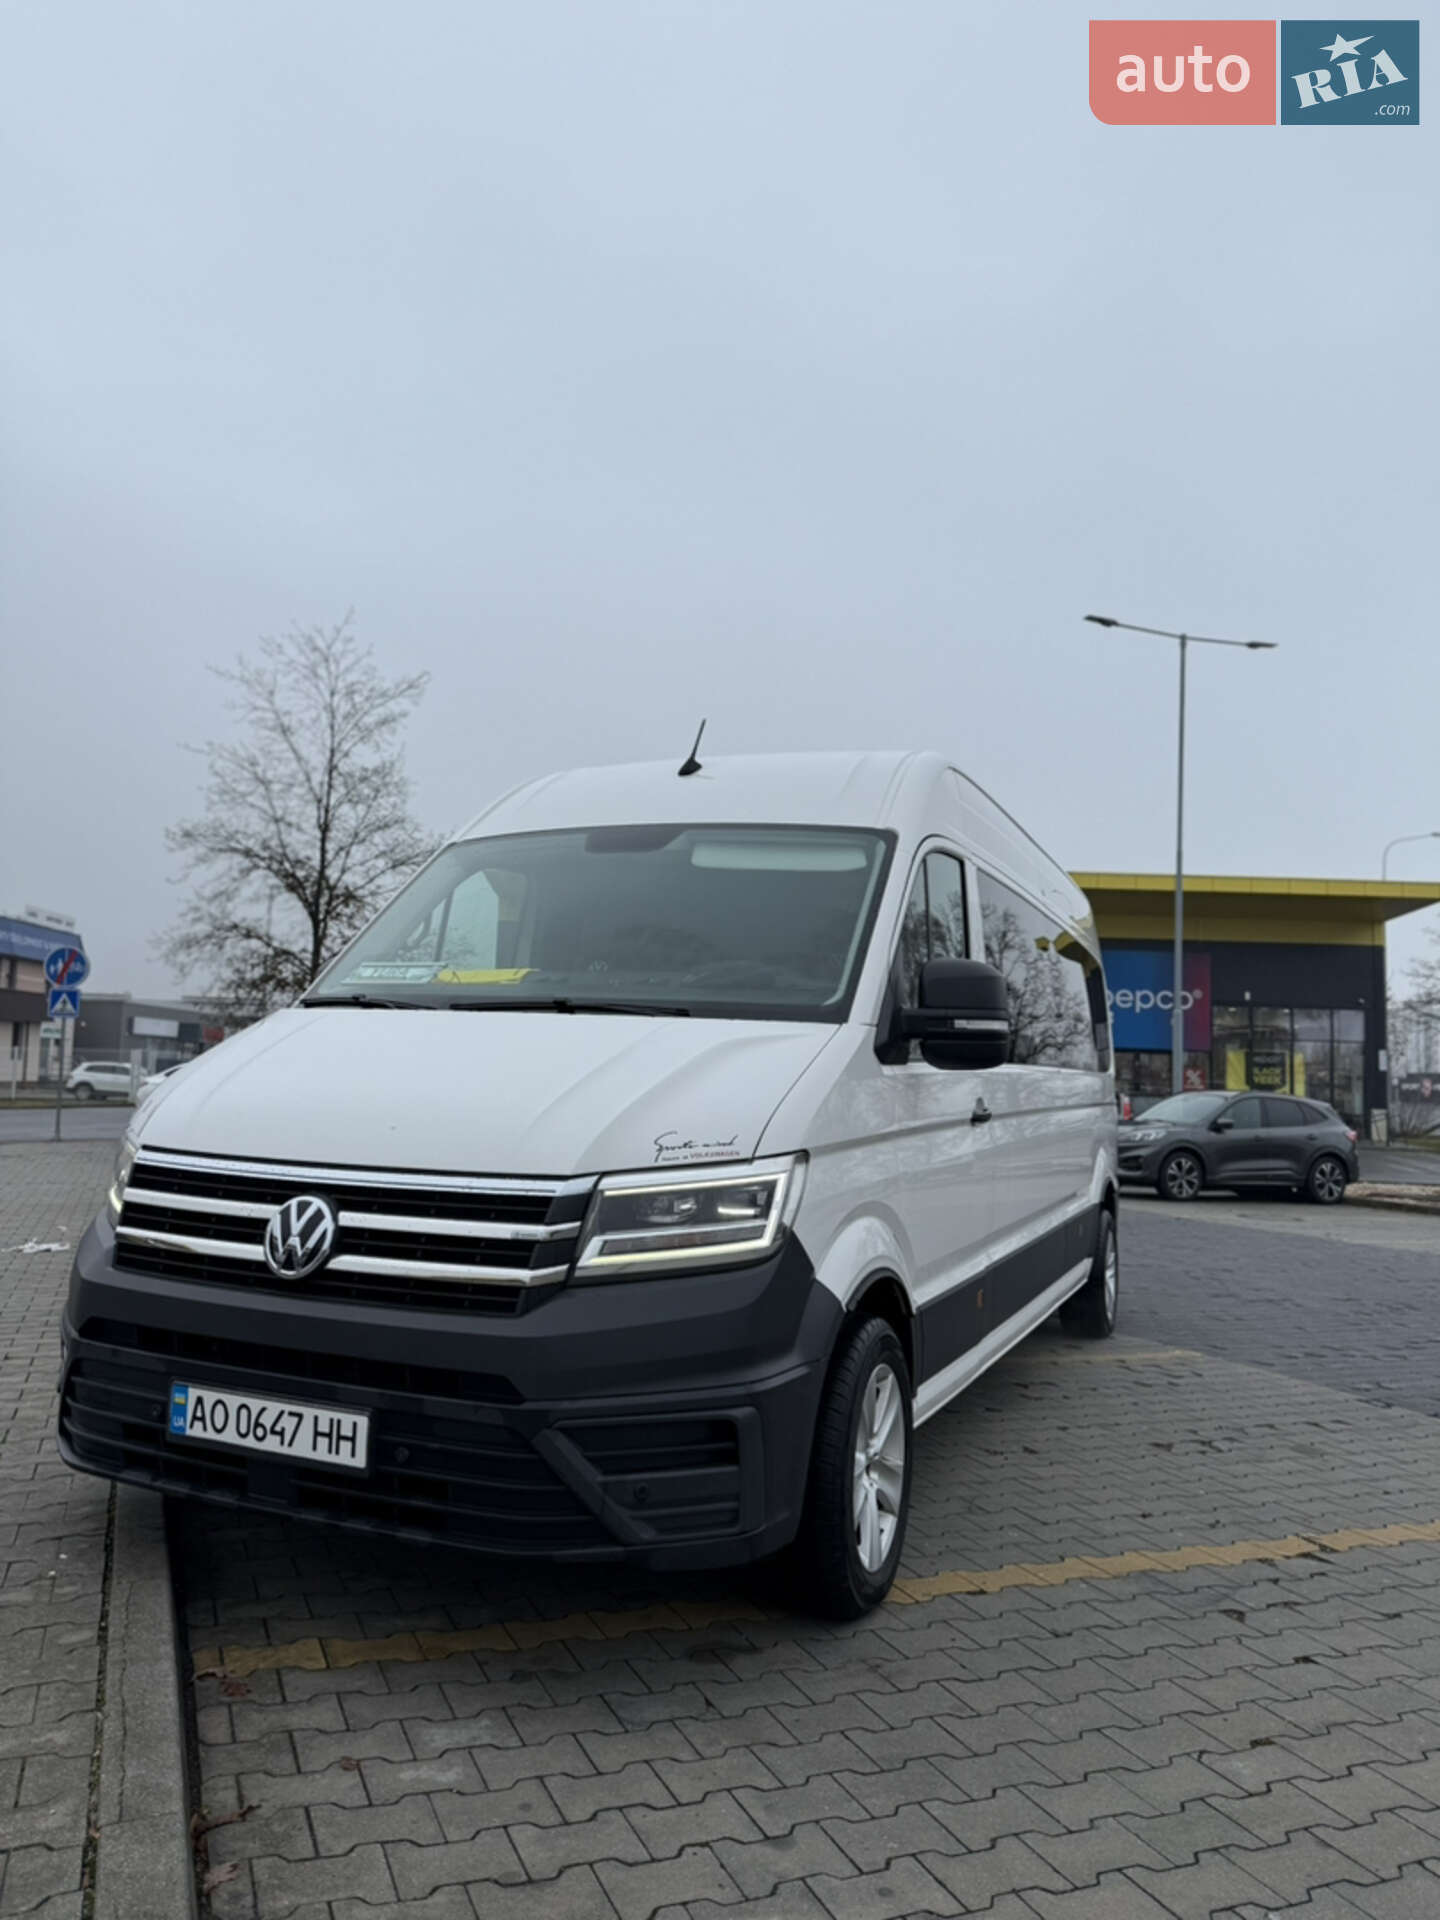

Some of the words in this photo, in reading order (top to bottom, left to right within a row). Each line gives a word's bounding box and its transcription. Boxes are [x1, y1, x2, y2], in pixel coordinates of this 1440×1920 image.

[189, 1396, 229, 1434] AO
[236, 1403, 304, 1448] 0647
[312, 1415, 358, 1459] HH
